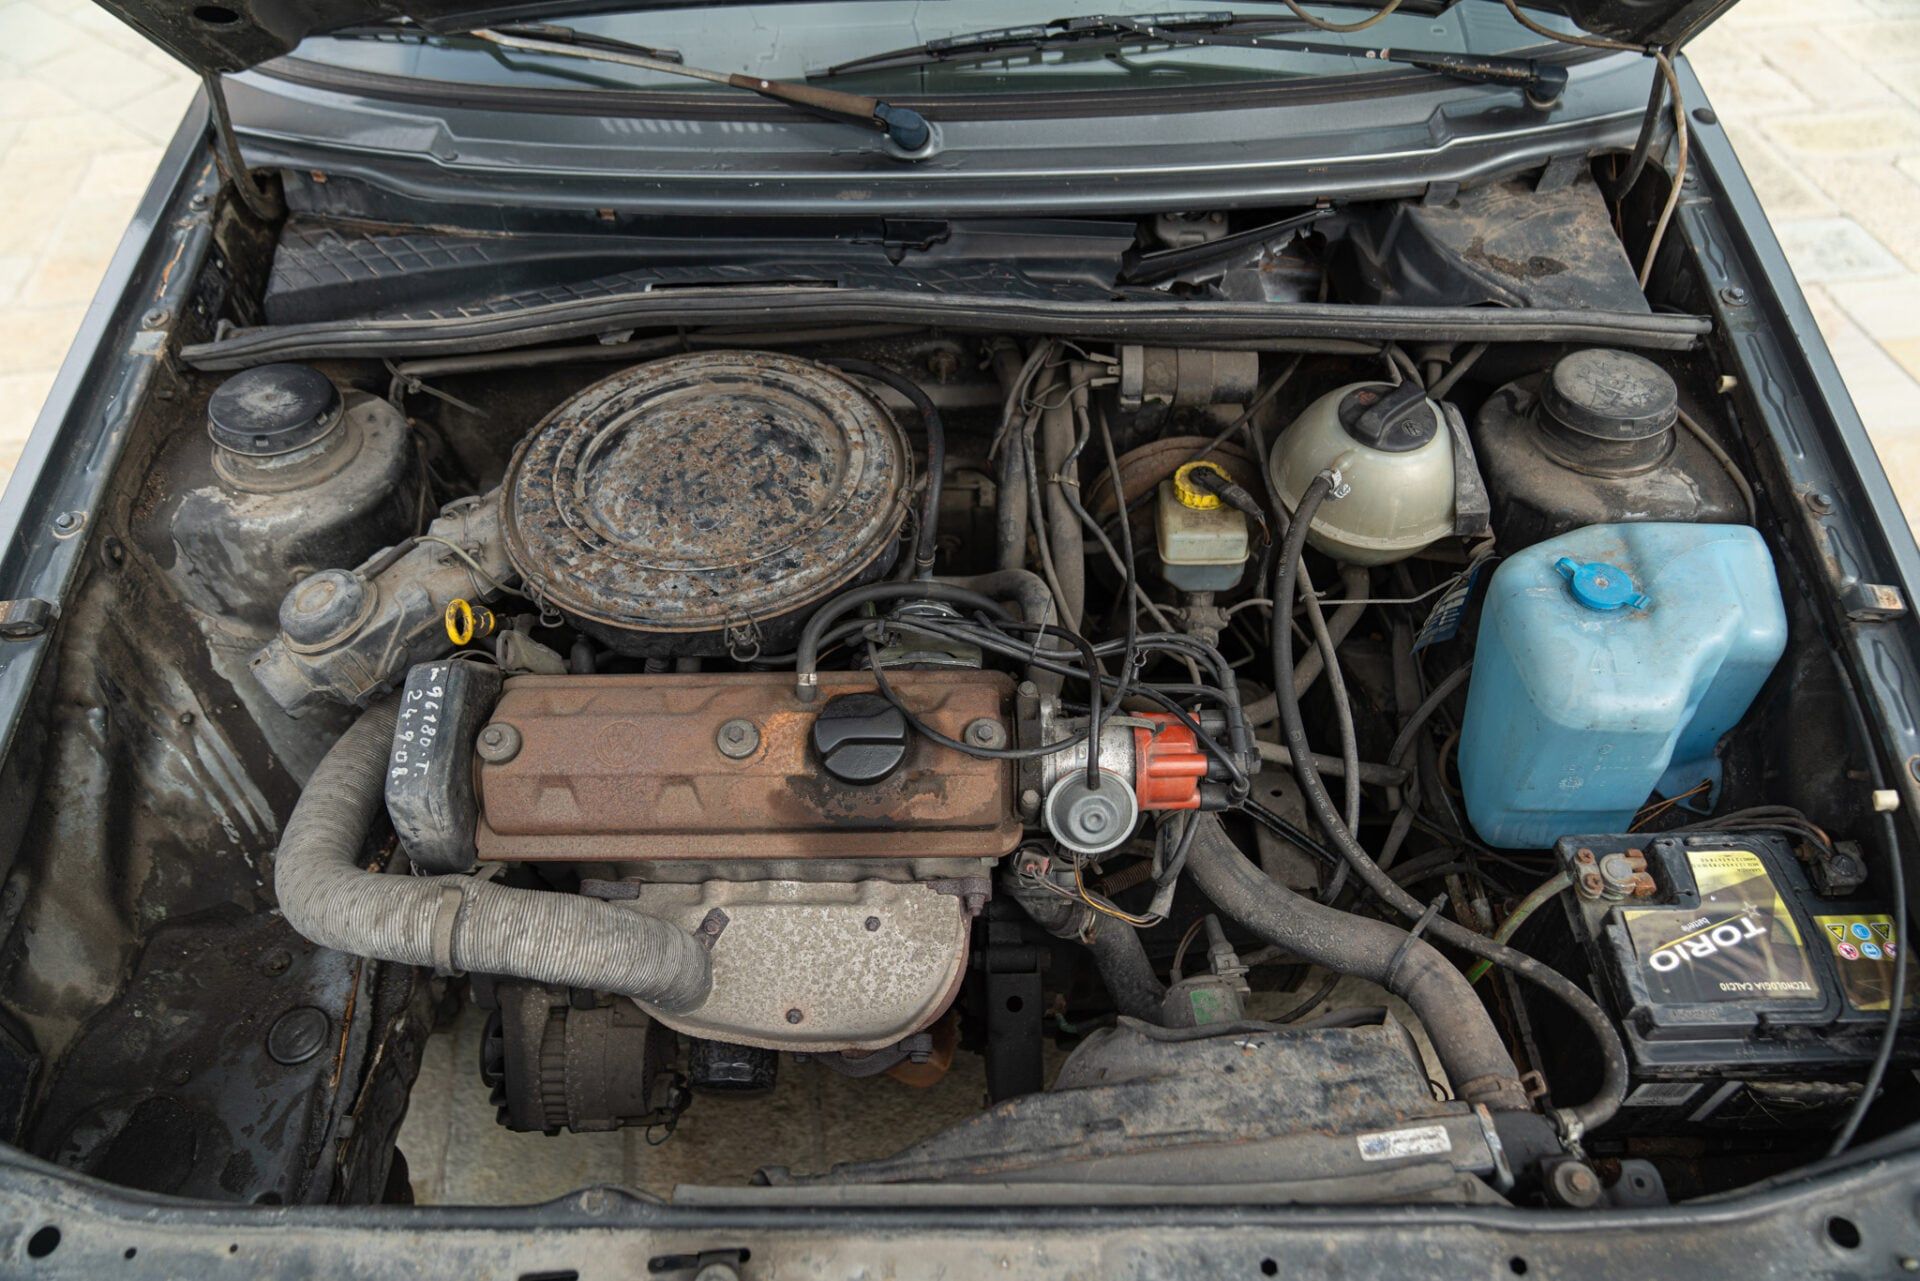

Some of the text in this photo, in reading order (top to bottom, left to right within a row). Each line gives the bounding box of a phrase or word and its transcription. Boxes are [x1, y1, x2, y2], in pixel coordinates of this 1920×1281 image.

[1649, 917, 1767, 972] TORIO
[1719, 980, 1812, 992] TECNOLOGIA CALCIO
